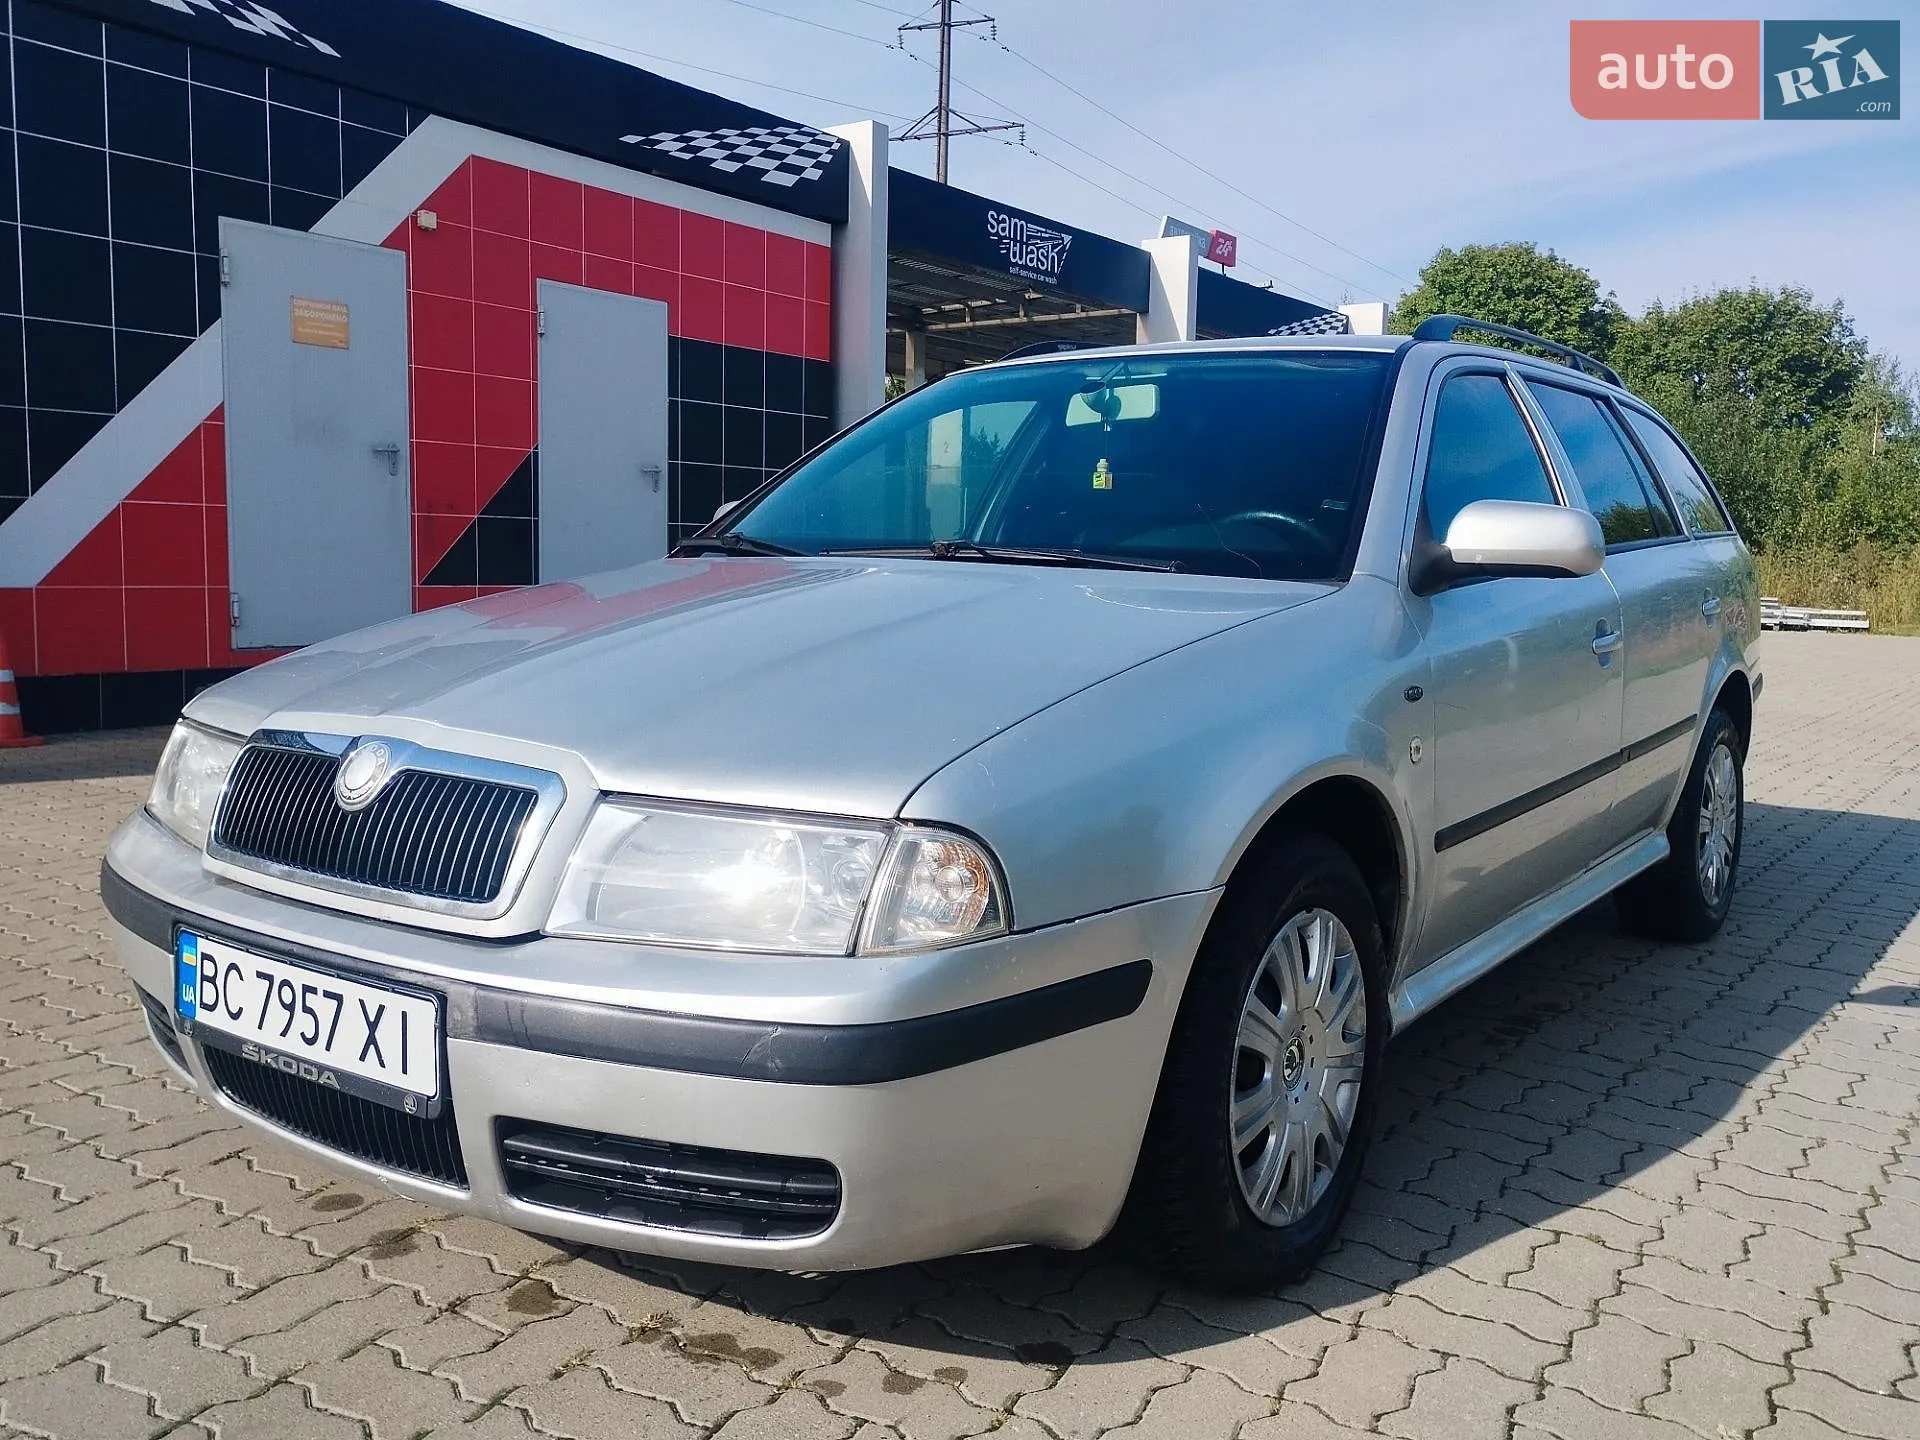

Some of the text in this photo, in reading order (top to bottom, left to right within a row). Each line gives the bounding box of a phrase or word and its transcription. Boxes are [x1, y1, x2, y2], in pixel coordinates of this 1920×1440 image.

[987, 210, 1027, 243] sam
[1009, 241, 1058, 274] wash
[182, 984, 196, 1004] UA
[199, 951, 245, 1021] BC
[255, 969, 344, 1052] 7957
